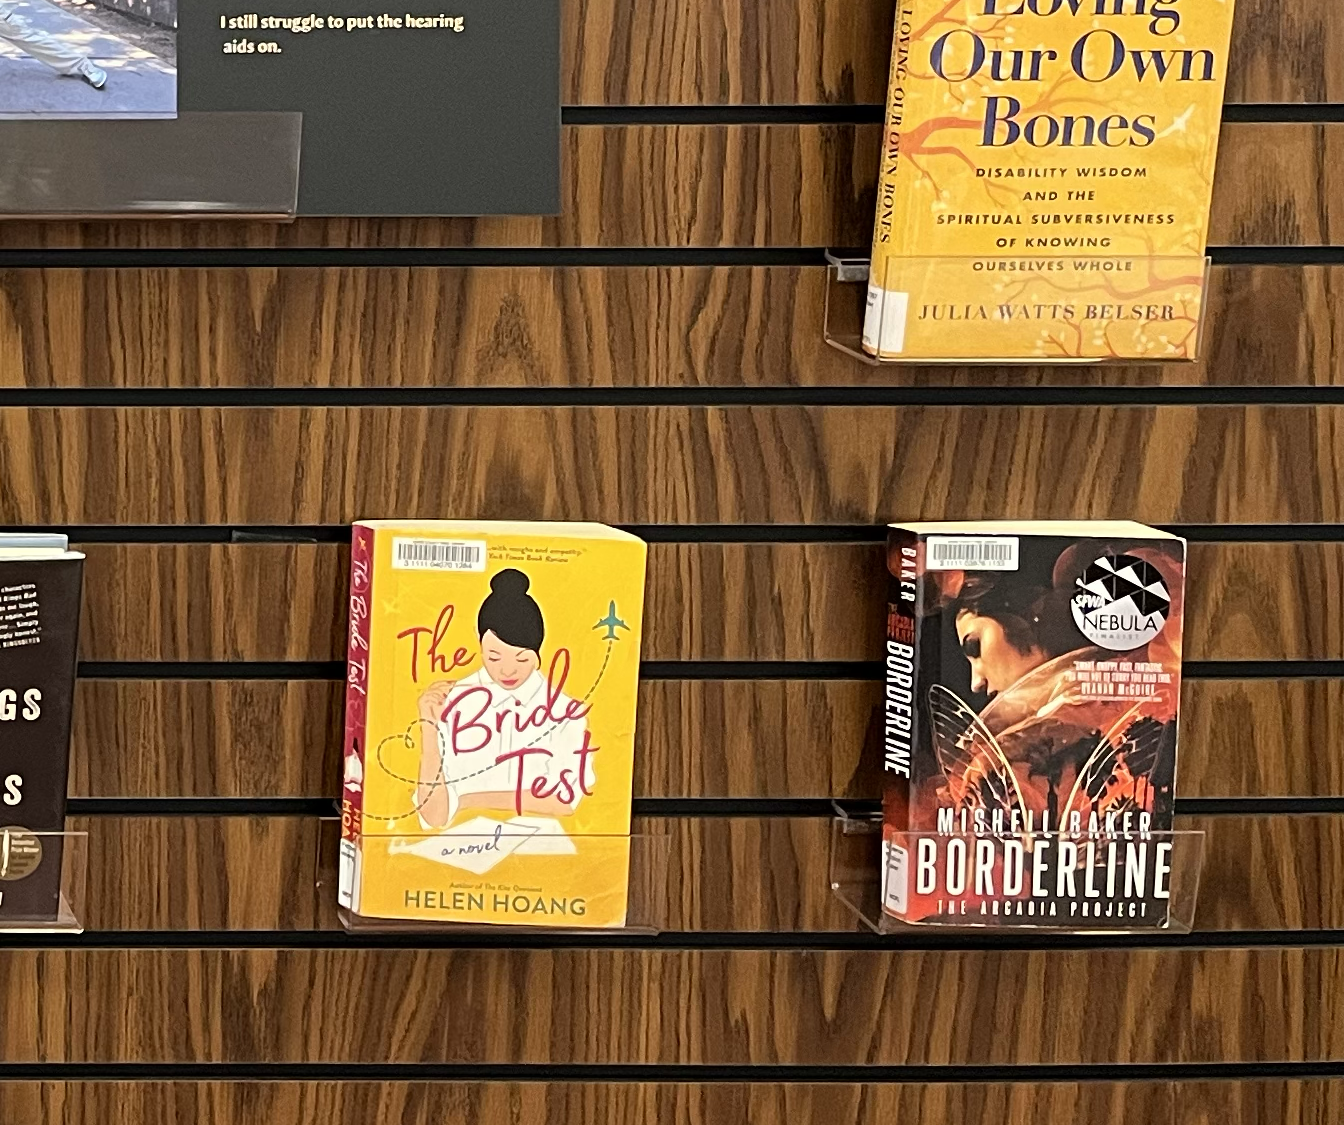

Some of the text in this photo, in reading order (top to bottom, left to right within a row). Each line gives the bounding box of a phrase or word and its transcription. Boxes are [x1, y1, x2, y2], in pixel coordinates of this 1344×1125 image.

[929, 28, 1216, 83] Our Own
[892, 87, 905, 126] OUR
[977, 96, 1155, 147] Bones
[887, 131, 900, 175] OWN
[976, 167, 1147, 178] DISABILITY WISDOM
[880, 183, 895, 243] BONES
[1023, 191, 1095, 201] AND THE
[937, 214, 1175, 224] SPIRITUAL SUBVERSIVENESS
[996, 237, 1112, 247] OF KNOWING
[972, 261, 1132, 272] OURSELVES WHOLE
[918, 305, 1175, 322] JULIA WATTS BELSER
[900, 547, 917, 602] BAKER
[1083, 615, 1158, 631] NEBULA
[397, 605, 477, 683] The
[441, 648, 595, 754] Bride
[884, 640, 914, 779] BORDERLINE
[496, 731, 600, 817] Test
[441, 825, 502, 857] a novel
[937, 808, 1152, 840] MISHELL BAKER
[916, 838, 1173, 899] BORDERLINE
[404, 889, 586, 916] HELEN HOANG
[938, 900, 1147, 917] THE ARCADIA PROJECT
